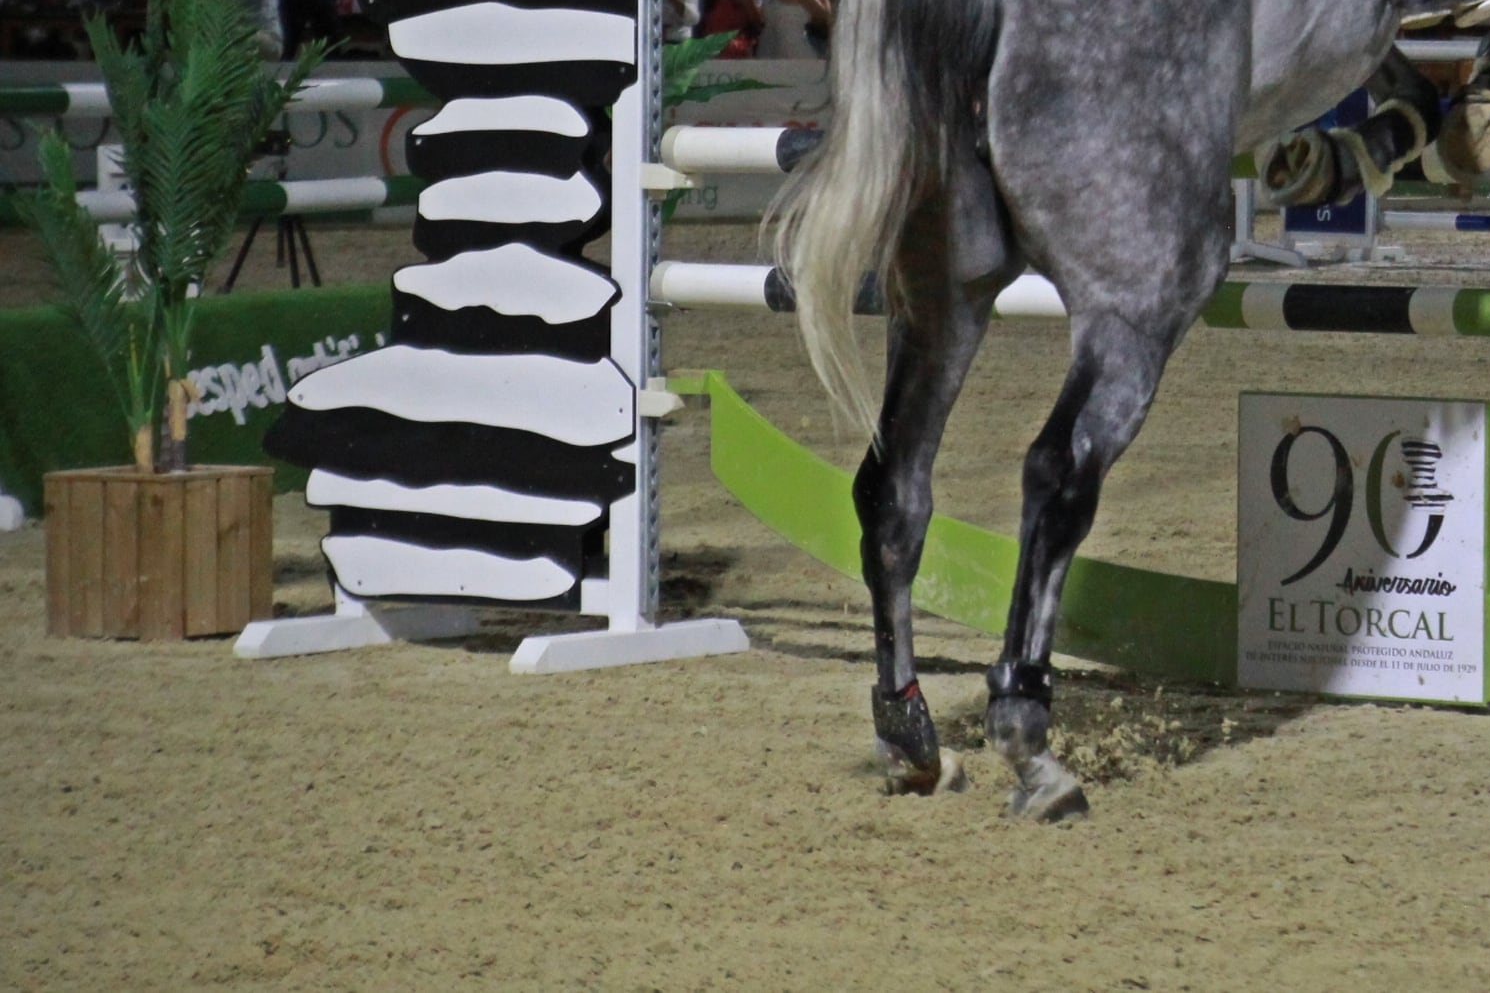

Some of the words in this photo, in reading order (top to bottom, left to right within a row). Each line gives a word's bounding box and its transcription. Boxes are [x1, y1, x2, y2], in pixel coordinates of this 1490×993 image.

[1269, 425, 1455, 587] 90
[1336, 568, 1457, 596] Aniversario
[1311, 599, 1455, 642] TORCAL
[1350, 658, 1377, 668] DESDE
[1379, 660, 1389, 669] EL
[1403, 661, 1414, 671] DE
[1416, 662, 1441, 672] JULIO
[1443, 664, 1454, 673] DE
[1457, 664, 1478, 674] 1929
[1351, 645, 1407, 658] PROTEGIDO
[1409, 649, 1454, 661] ANDALUZ
